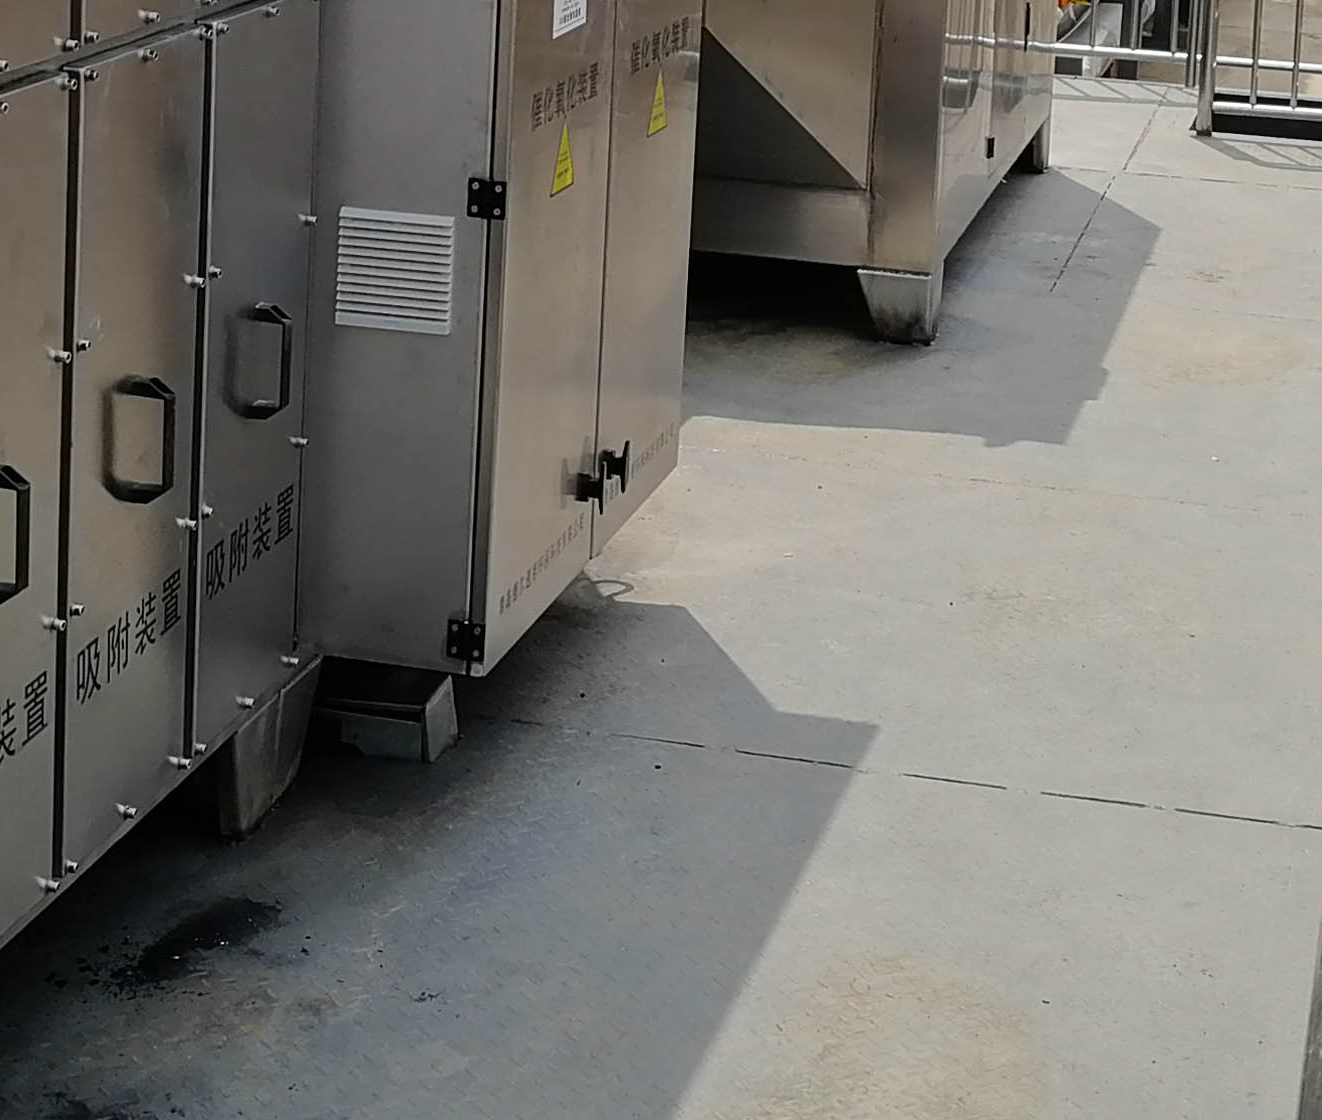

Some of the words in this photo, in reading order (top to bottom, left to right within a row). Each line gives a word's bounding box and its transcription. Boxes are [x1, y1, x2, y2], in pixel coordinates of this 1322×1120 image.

[532, 62, 599, 130] 催化氧化装置
[205, 484, 295, 600] 吸附装置
[76, 567, 182, 705] 吸附装置
